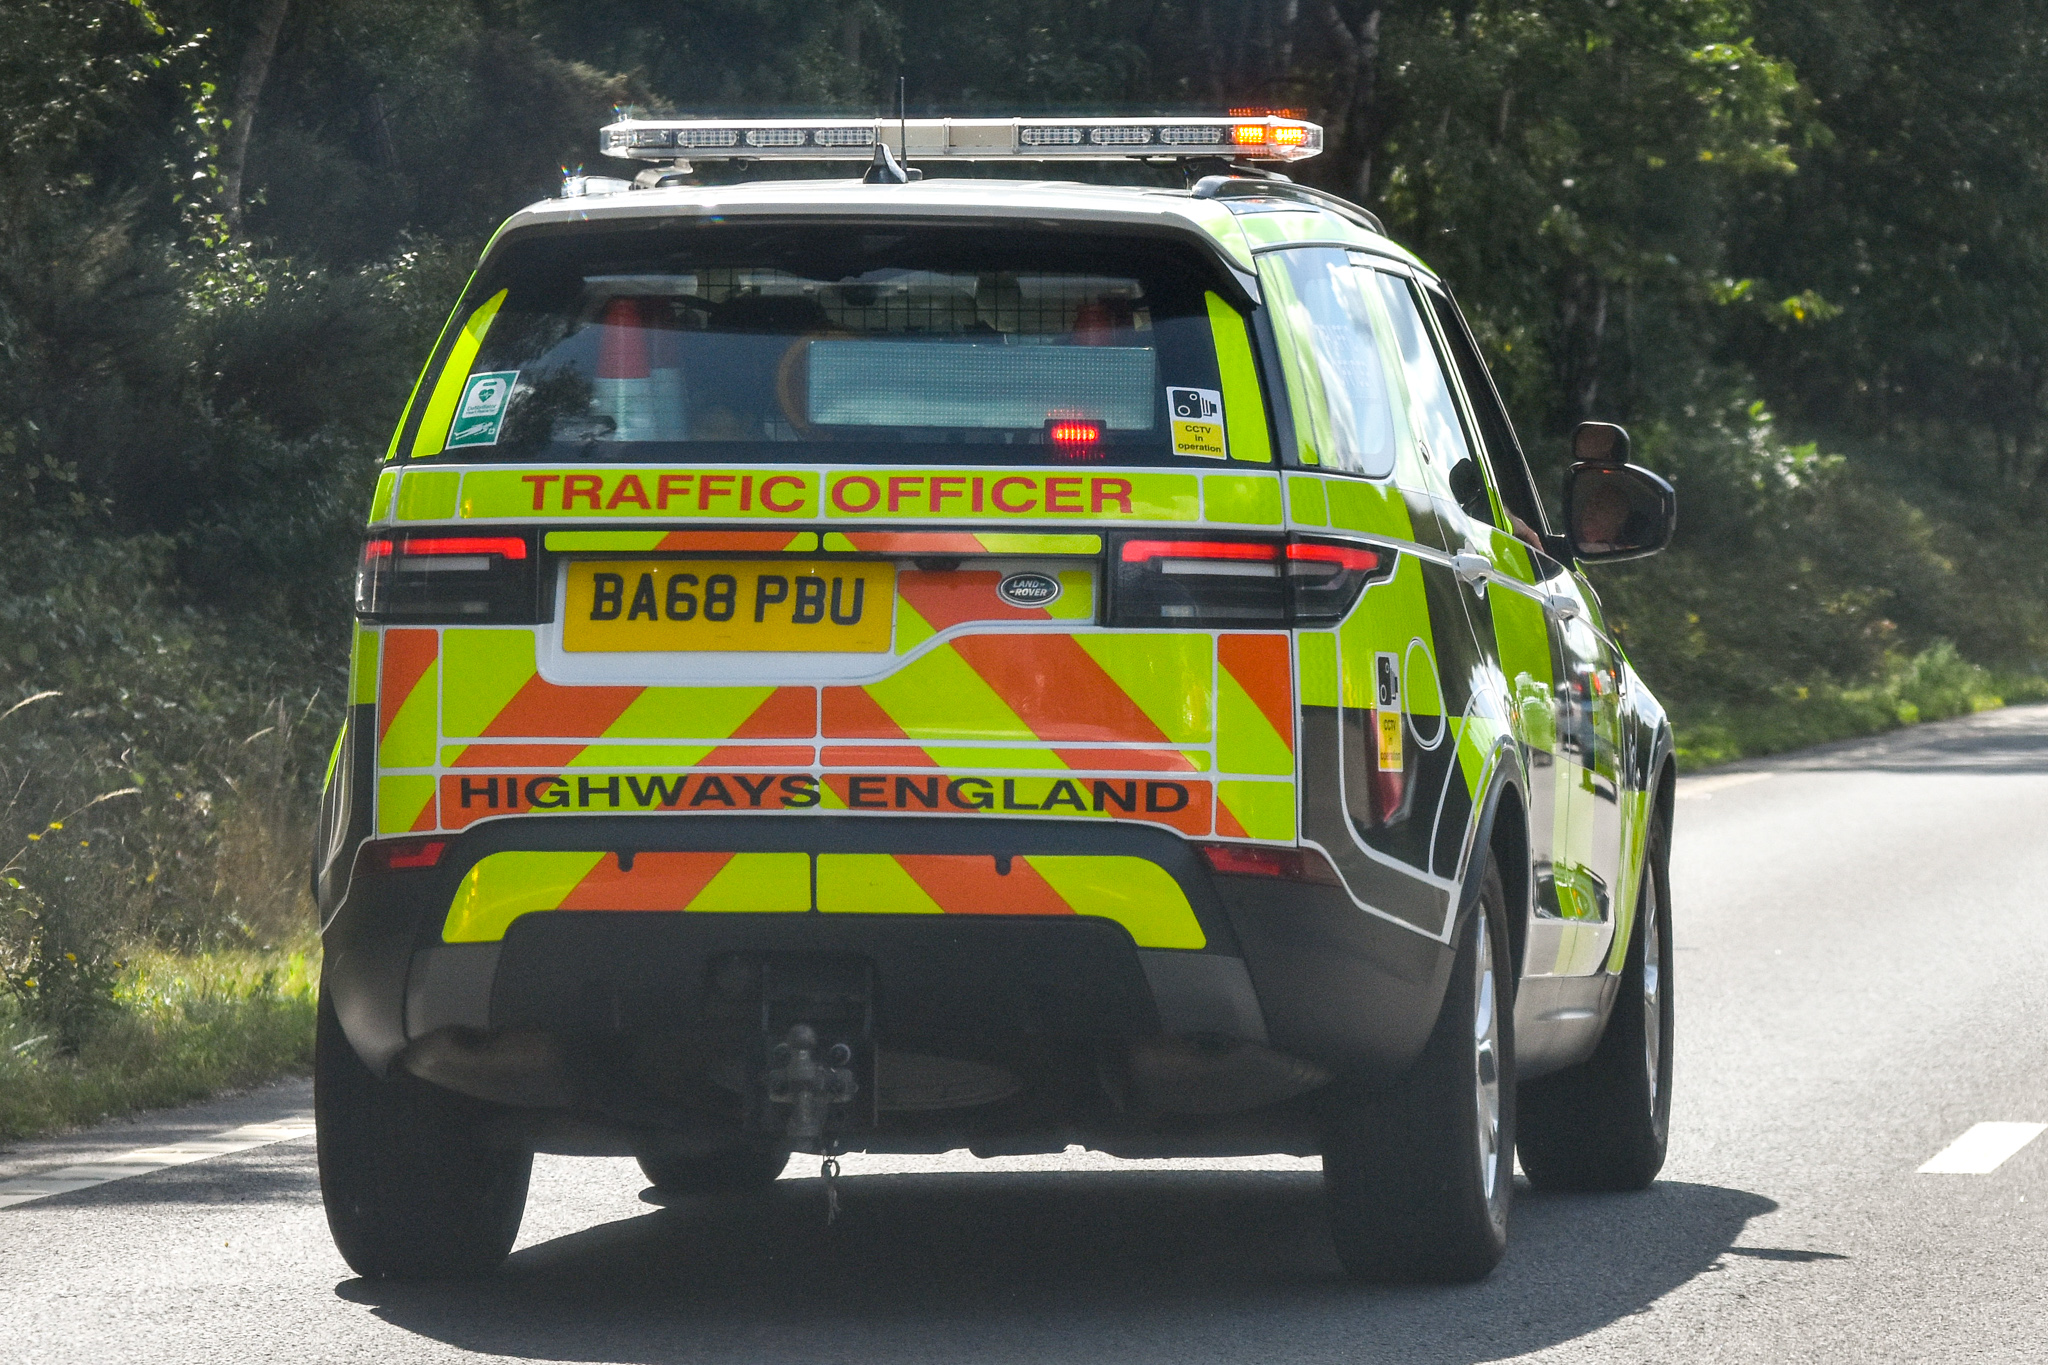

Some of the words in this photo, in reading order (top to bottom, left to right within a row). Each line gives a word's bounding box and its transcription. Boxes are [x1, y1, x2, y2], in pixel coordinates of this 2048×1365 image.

[1185, 424, 1211, 434] CCTV
[1194, 434, 1204, 442] in
[1177, 443, 1222, 453] operation
[522, 474, 806, 513] TRAFFIC
[831, 475, 1134, 514] OFFICER
[589, 572, 738, 622] BA68
[753, 575, 865, 626] PBU
[460, 776, 821, 809] HIGHWAYS
[848, 776, 1190, 813] ENGLAND
